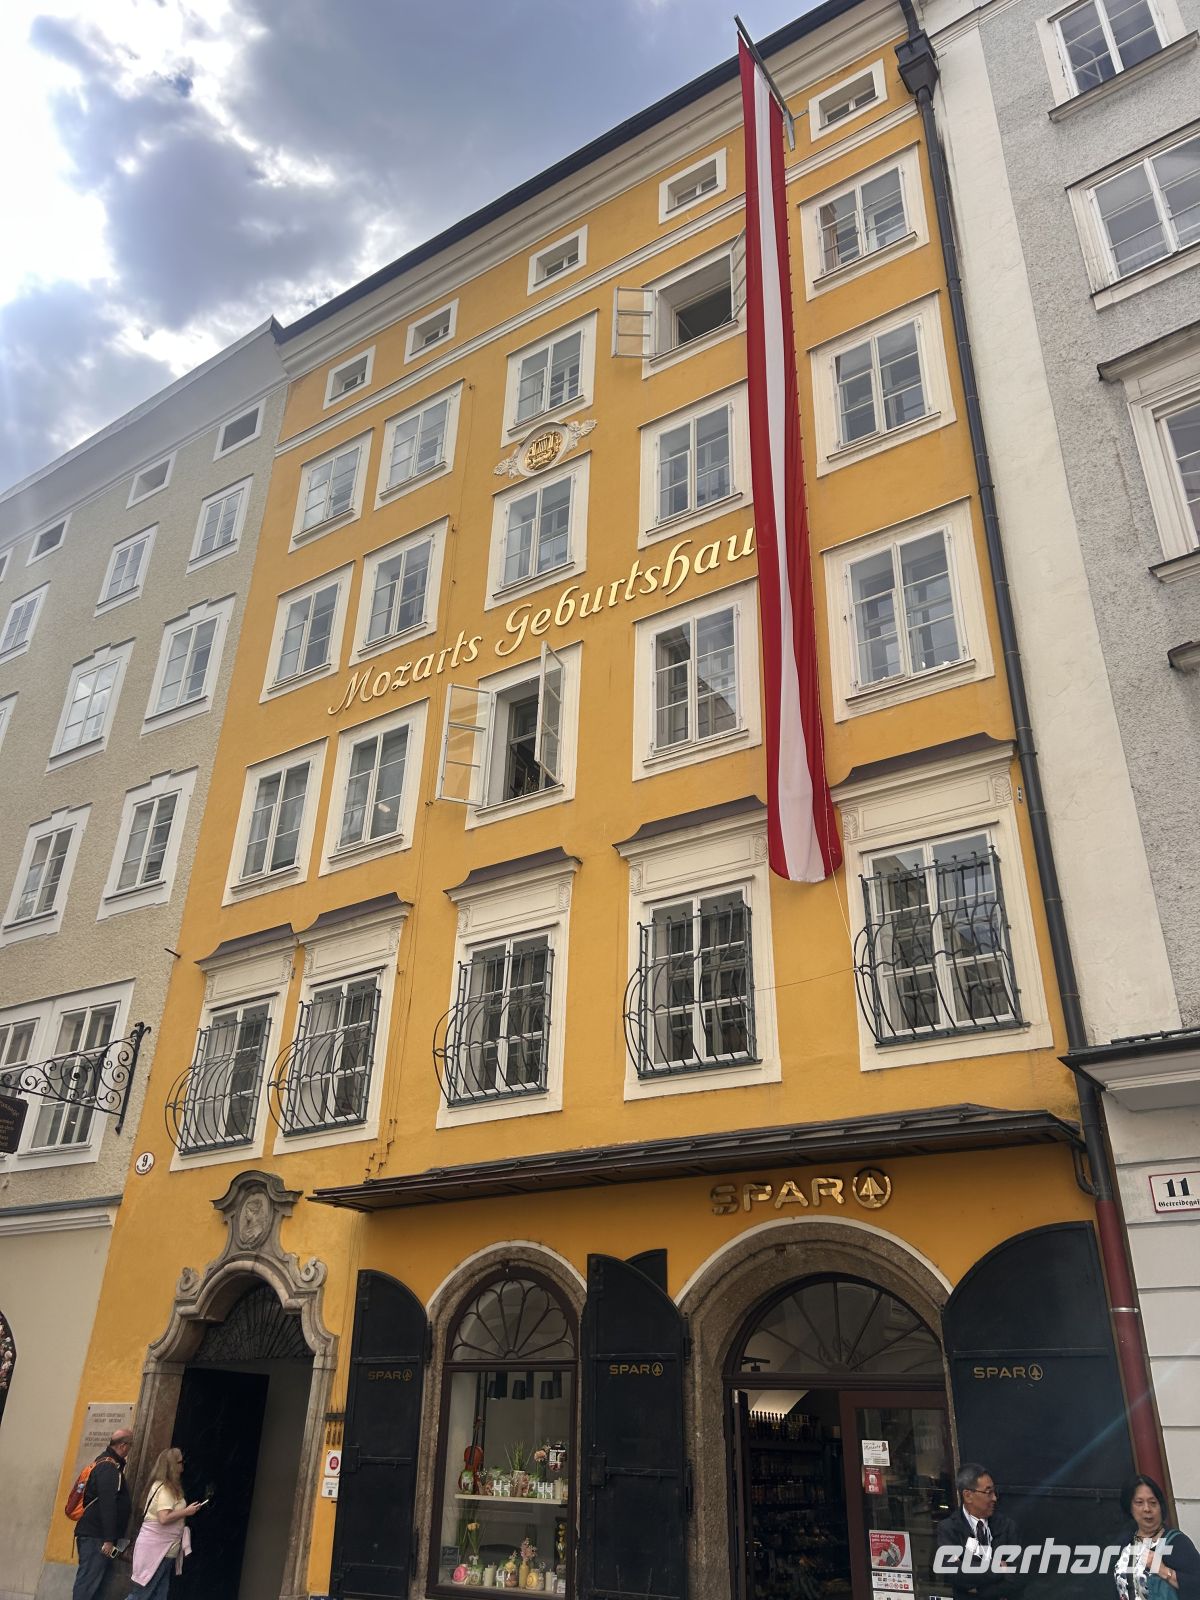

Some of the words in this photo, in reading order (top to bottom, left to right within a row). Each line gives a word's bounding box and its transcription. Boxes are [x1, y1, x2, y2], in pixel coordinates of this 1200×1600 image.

[327, 630, 483, 717] Mozarts
[494, 525, 756, 657] Geburtshau
[141, 1154, 149, 1167] 9
[1162, 1177, 1194, 1198] 11
[709, 1176, 845, 1216] SPAR
[367, 1370, 402, 1381] SPAR
[609, 1363, 650, 1375] SPAR
[973, 1366, 1026, 1379] SPAR
